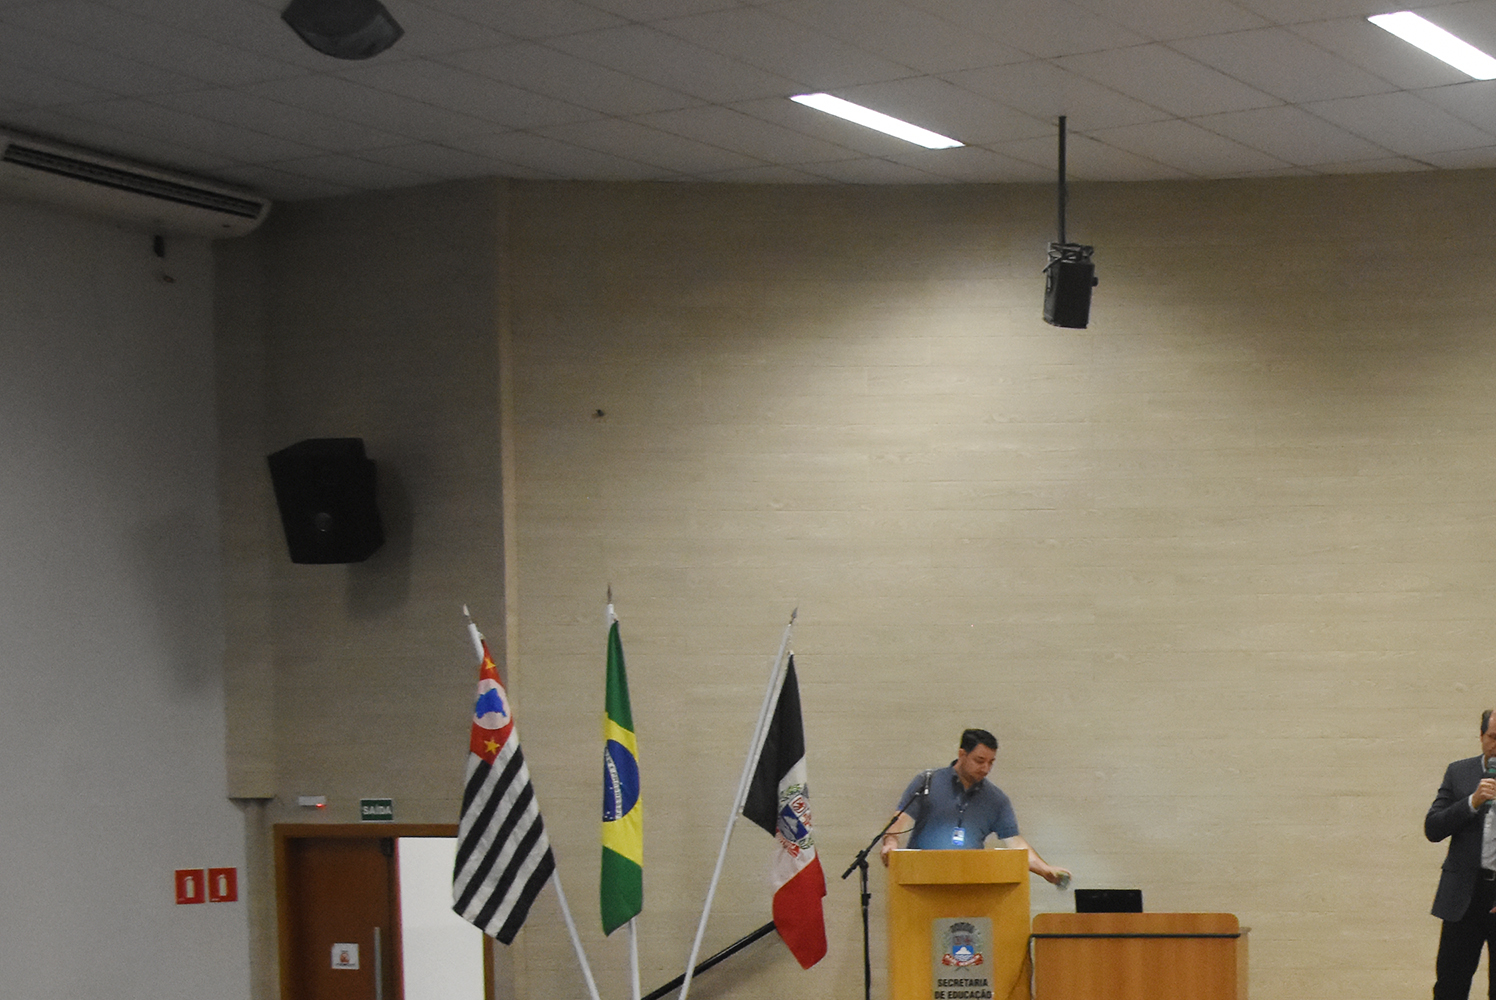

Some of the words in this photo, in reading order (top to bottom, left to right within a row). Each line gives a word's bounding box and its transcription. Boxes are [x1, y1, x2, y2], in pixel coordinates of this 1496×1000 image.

[362, 804, 393, 816] SAÍDA
[937, 978, 988, 988] SECRETARIA
[934, 990, 946, 1000] DE
[947, 988, 993, 1000] EDUCAÇÃO
